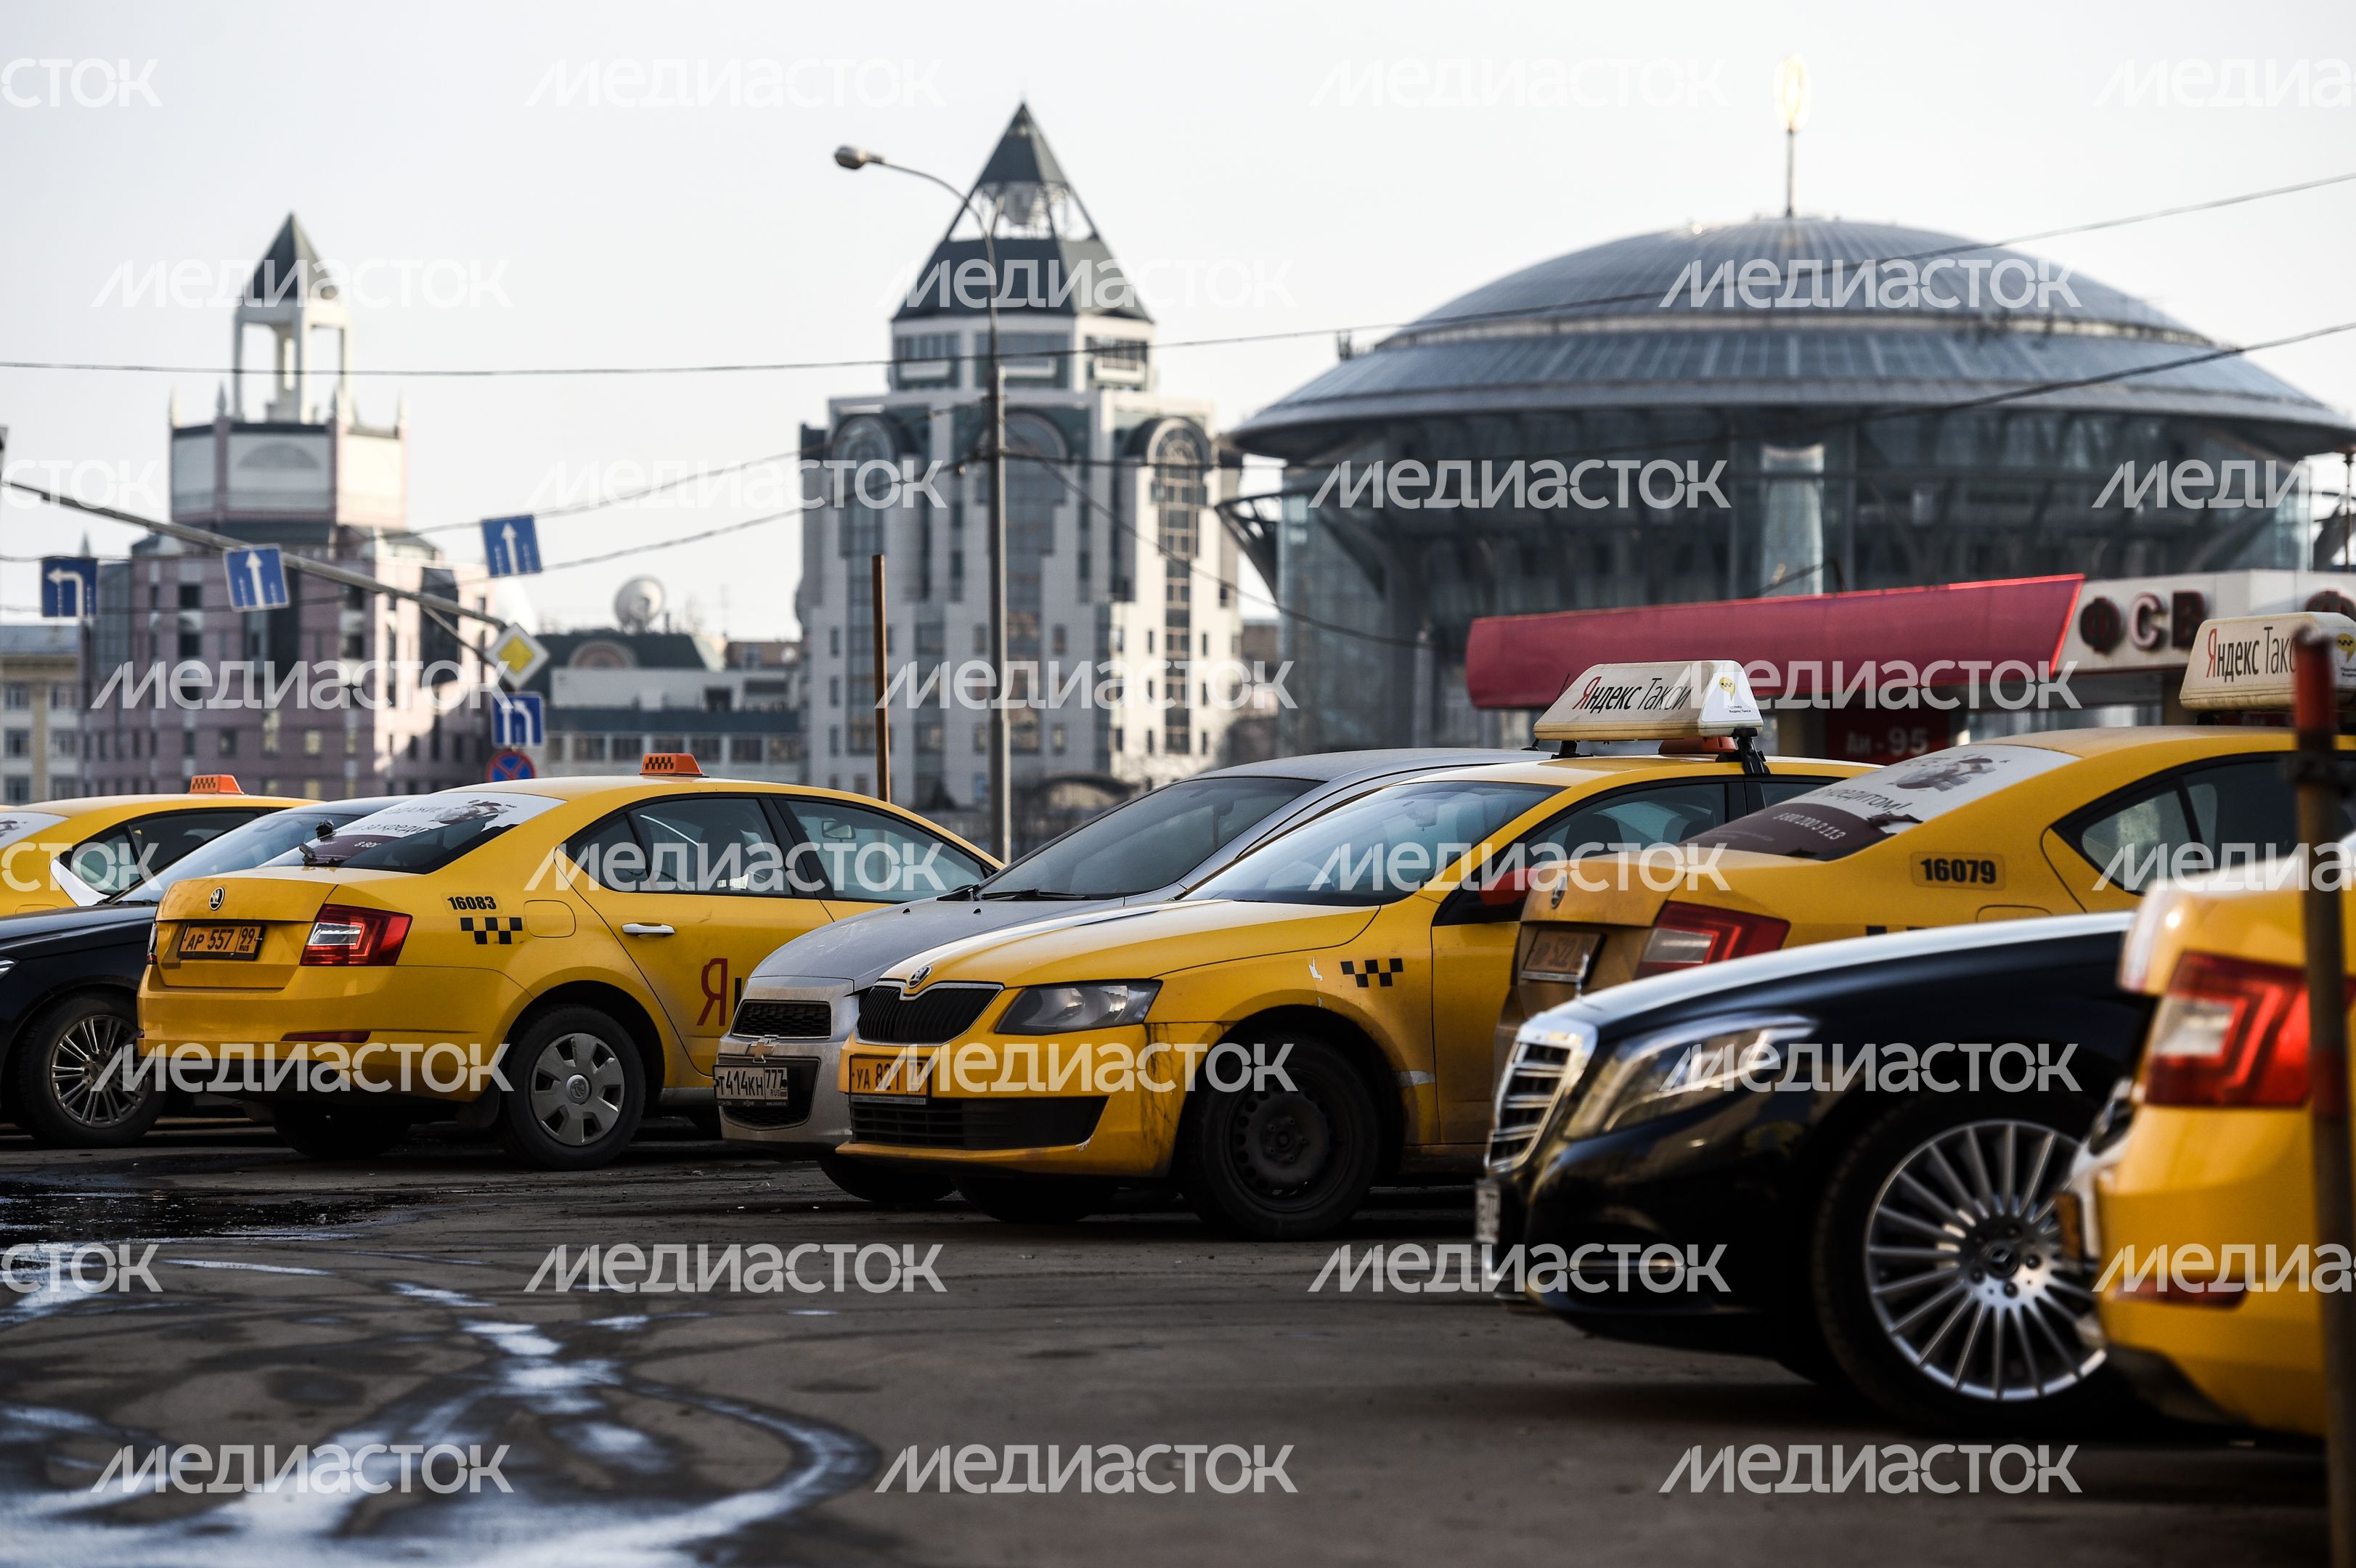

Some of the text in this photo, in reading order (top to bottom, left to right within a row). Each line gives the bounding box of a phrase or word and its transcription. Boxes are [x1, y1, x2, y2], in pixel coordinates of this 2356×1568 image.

[2206, 626, 2297, 682] Яндекс Такс
[1572, 676, 1694, 714] Яндекс Такси
[1920, 858, 1997, 884] 16079
[447, 896, 497, 910] 16083
[207, 928, 235, 950] 557
[240, 928, 256, 944] 99
[765, 1069, 784, 1089] 777
